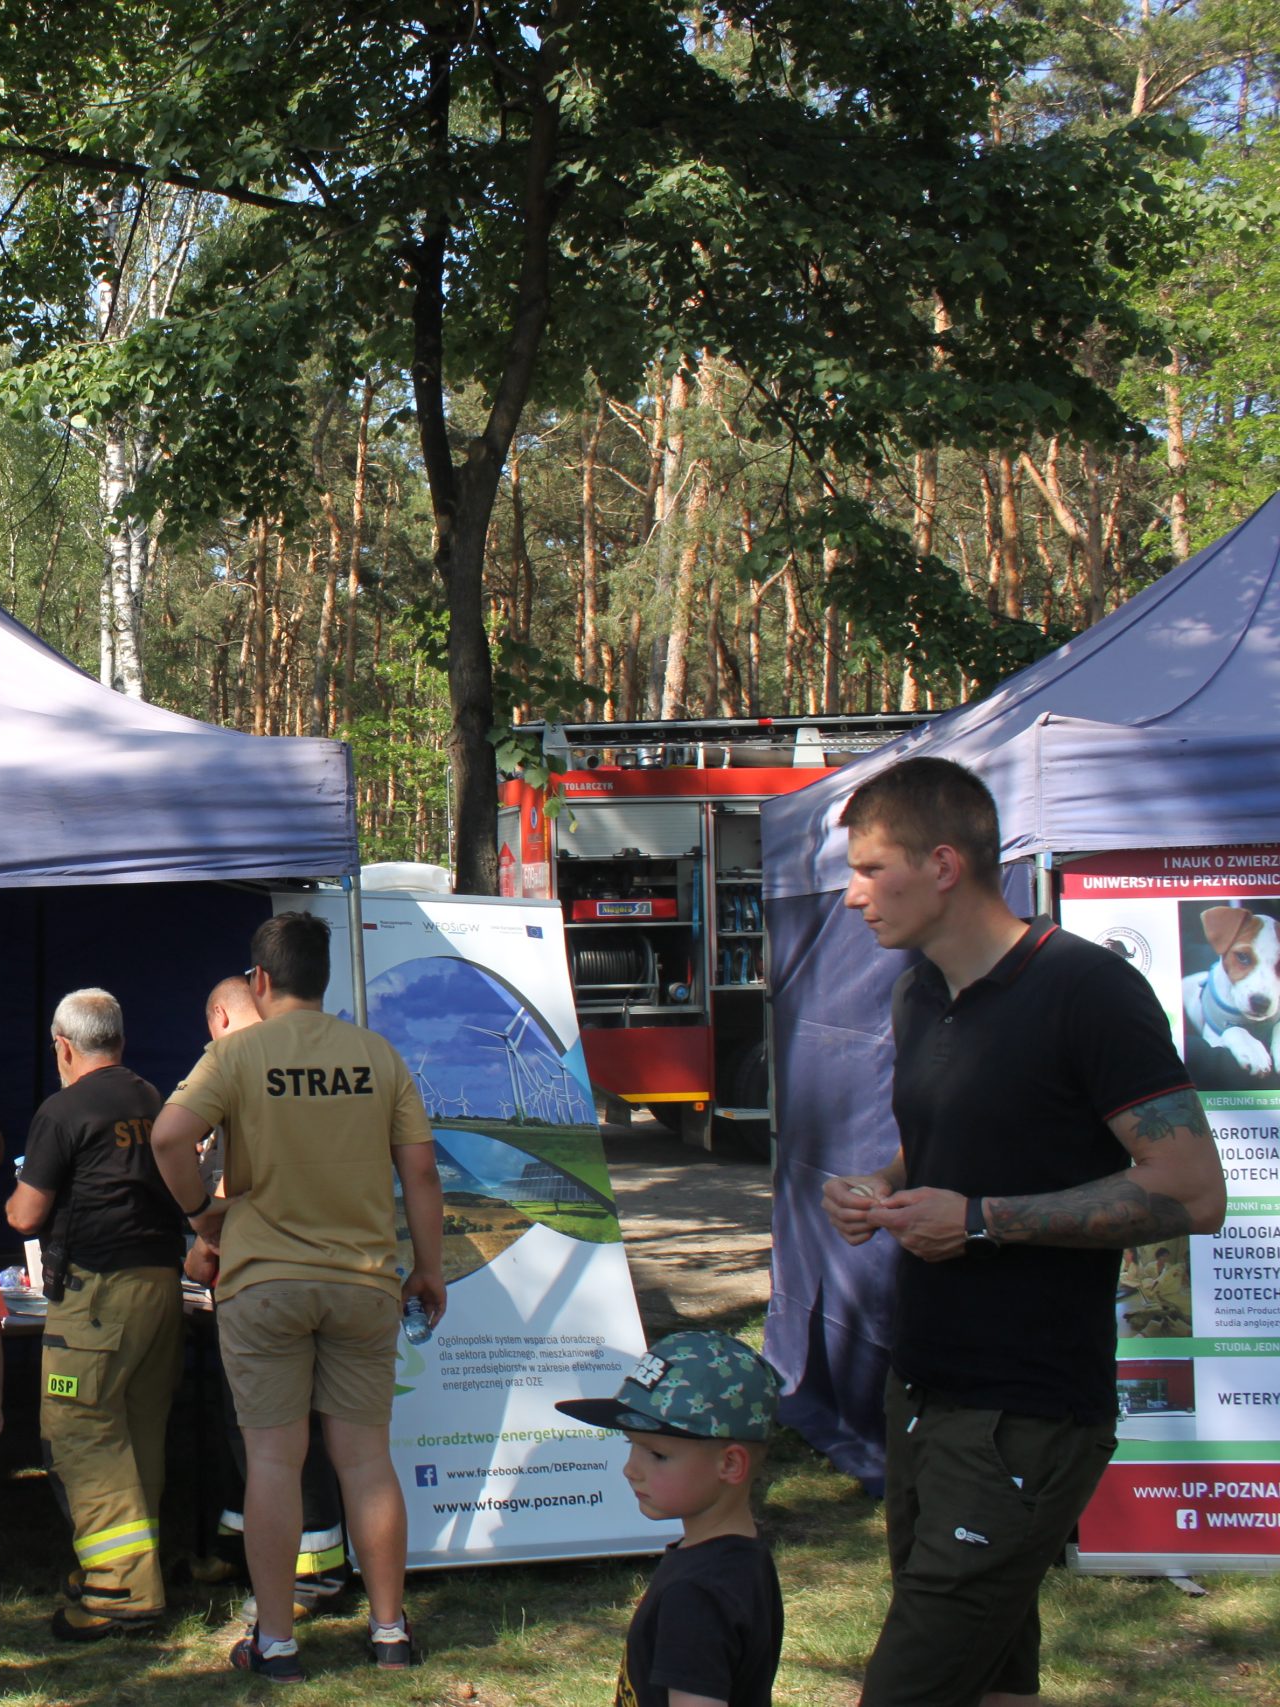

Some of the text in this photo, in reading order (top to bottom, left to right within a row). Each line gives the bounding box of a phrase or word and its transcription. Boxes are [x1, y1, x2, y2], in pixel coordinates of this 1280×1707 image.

[562, 782, 613, 791] TOLARCZYK
[1164, 855, 1280, 868] I NAUK O ZWIERZ
[1083, 873, 1280, 889] UNIWERSYTETU PRZYRODNIC
[1206, 1096, 1254, 1106] KIERUNKI
[1256, 1098, 1268, 1106] na
[1211, 1127, 1279, 1140] AGROTUR
[1221, 1147, 1279, 1160] IOLOGIA
[1223, 1168, 1278, 1180] OOTECH
[1227, 1202, 1258, 1211] RUNKI
[1260, 1203, 1273, 1211] na
[1214, 1268, 1280, 1280] TURYSTY
[1215, 1307, 1245, 1315] Animal
[1215, 1318, 1241, 1327] studia
[438, 1334, 605, 1347] Ogólnopolski system wsparcia doradczego
[1214, 1342, 1280, 1351] STUDIA JEDN
[439, 1351, 453, 1361] dla
[455, 1350, 486, 1360] sektora
[540, 1348, 604, 1359] mieszkaniowego
[441, 1360, 622, 1376] oraz przedsiębiorstw w zakresie efektywności
[51, 1378, 73, 1393] OSP
[443, 1376, 544, 1391] energetycznej oraz OZE
[1218, 1393, 1280, 1405] WETERY
[447, 1460, 608, 1479] www.facebook.com/DEPoznan/
[433, 1491, 603, 1514] www.wfosgw.poznan.pl
